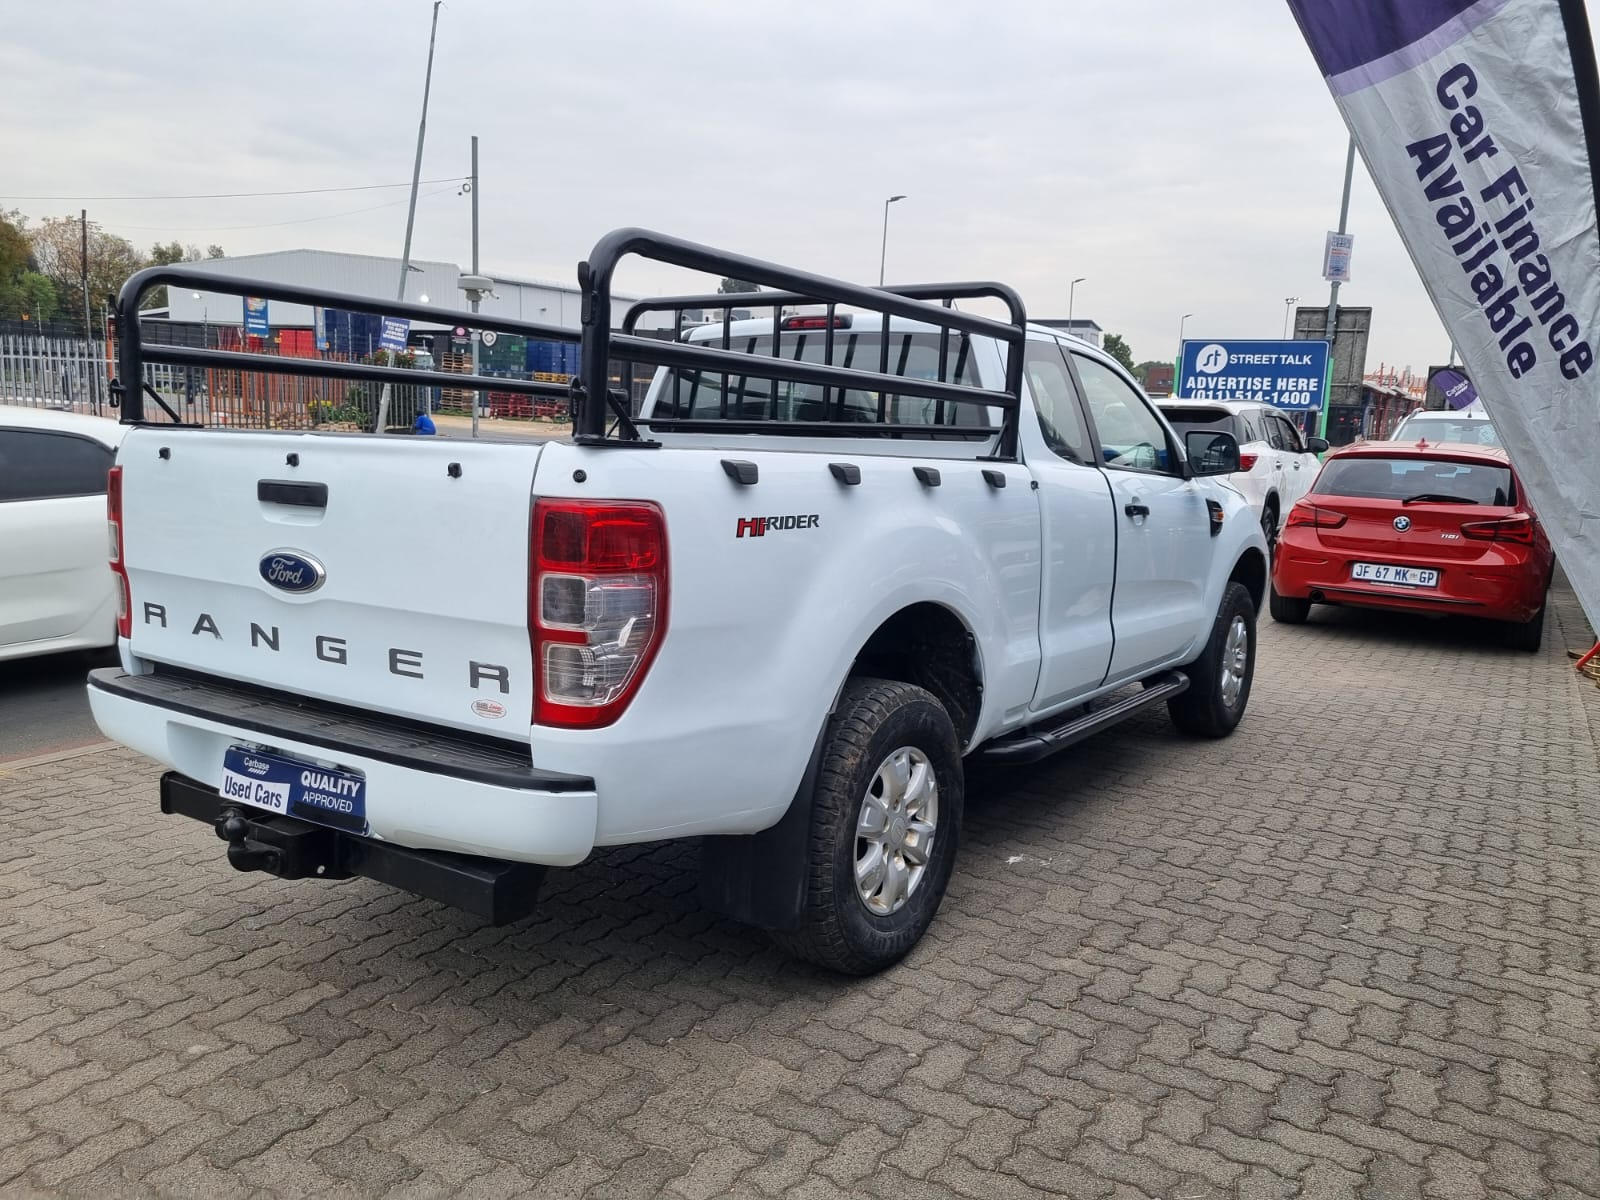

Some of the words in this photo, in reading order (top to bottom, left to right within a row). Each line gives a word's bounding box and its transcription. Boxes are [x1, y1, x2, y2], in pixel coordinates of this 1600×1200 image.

[1436, 62, 1499, 164] Car
[1480, 165, 1593, 381] Finance
[1405, 132, 1537, 380] Available
[1229, 354, 1277, 365] STREET
[1279, 354, 1312, 366] TALK
[1186, 376, 1272, 390] ADVERTISE
[1277, 378, 1319, 391] HERE
[268, 557, 304, 584] Ford
[1356, 565, 1370, 577] JF
[1375, 567, 1389, 579] 67
[1394, 569, 1409, 582] MK
[1419, 571, 1434, 584] GP
[144, 601, 510, 695] RANGER
[243, 756, 270, 770] Carbase
[224, 775, 252, 799] Used
[254, 783, 282, 809] Cars
[301, 770, 361, 798] QUALITY
[302, 791, 353, 814] APPROVED
